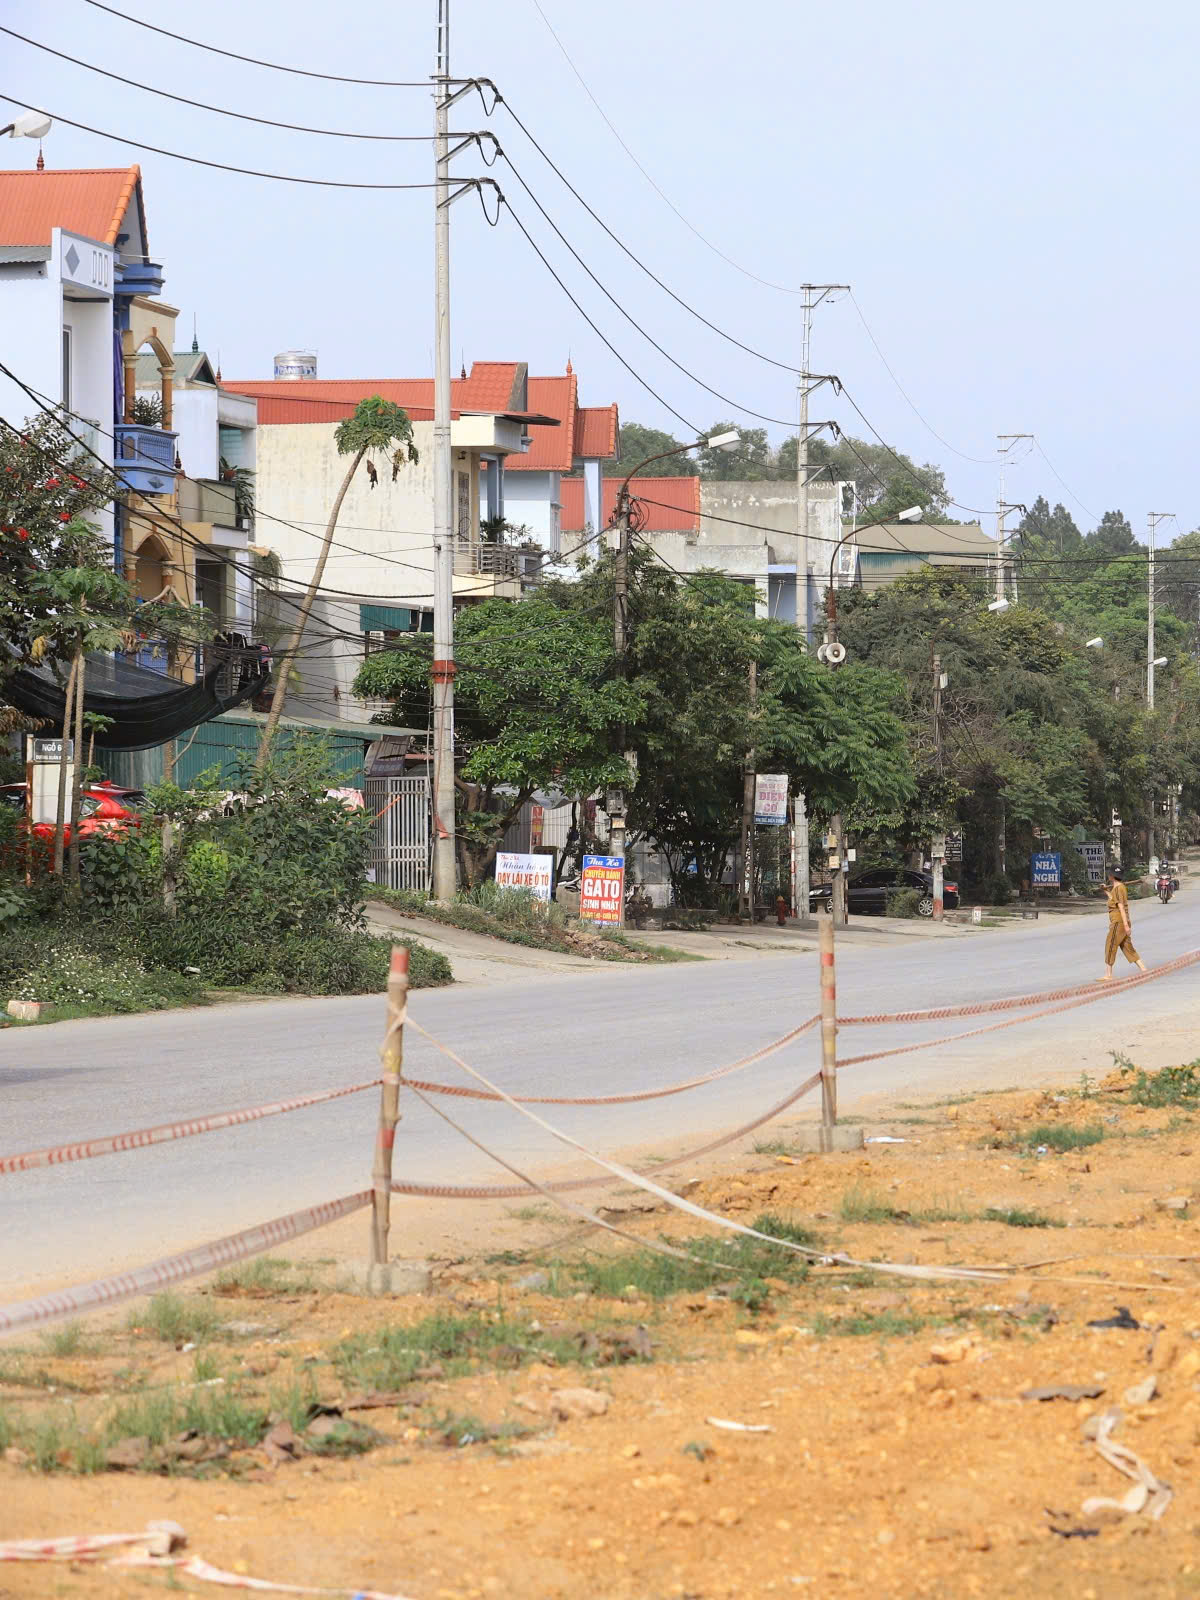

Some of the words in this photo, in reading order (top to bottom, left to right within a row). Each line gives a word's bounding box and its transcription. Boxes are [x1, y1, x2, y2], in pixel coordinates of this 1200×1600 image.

[587, 857, 604, 866] Thu
[1035, 859, 1057, 870] NHÀ
[524, 873, 533, 886] XE
[1033, 870, 1059, 882] NGHỈ
[583, 878, 620, 899] GATO
[583, 899, 600, 909] SINH
